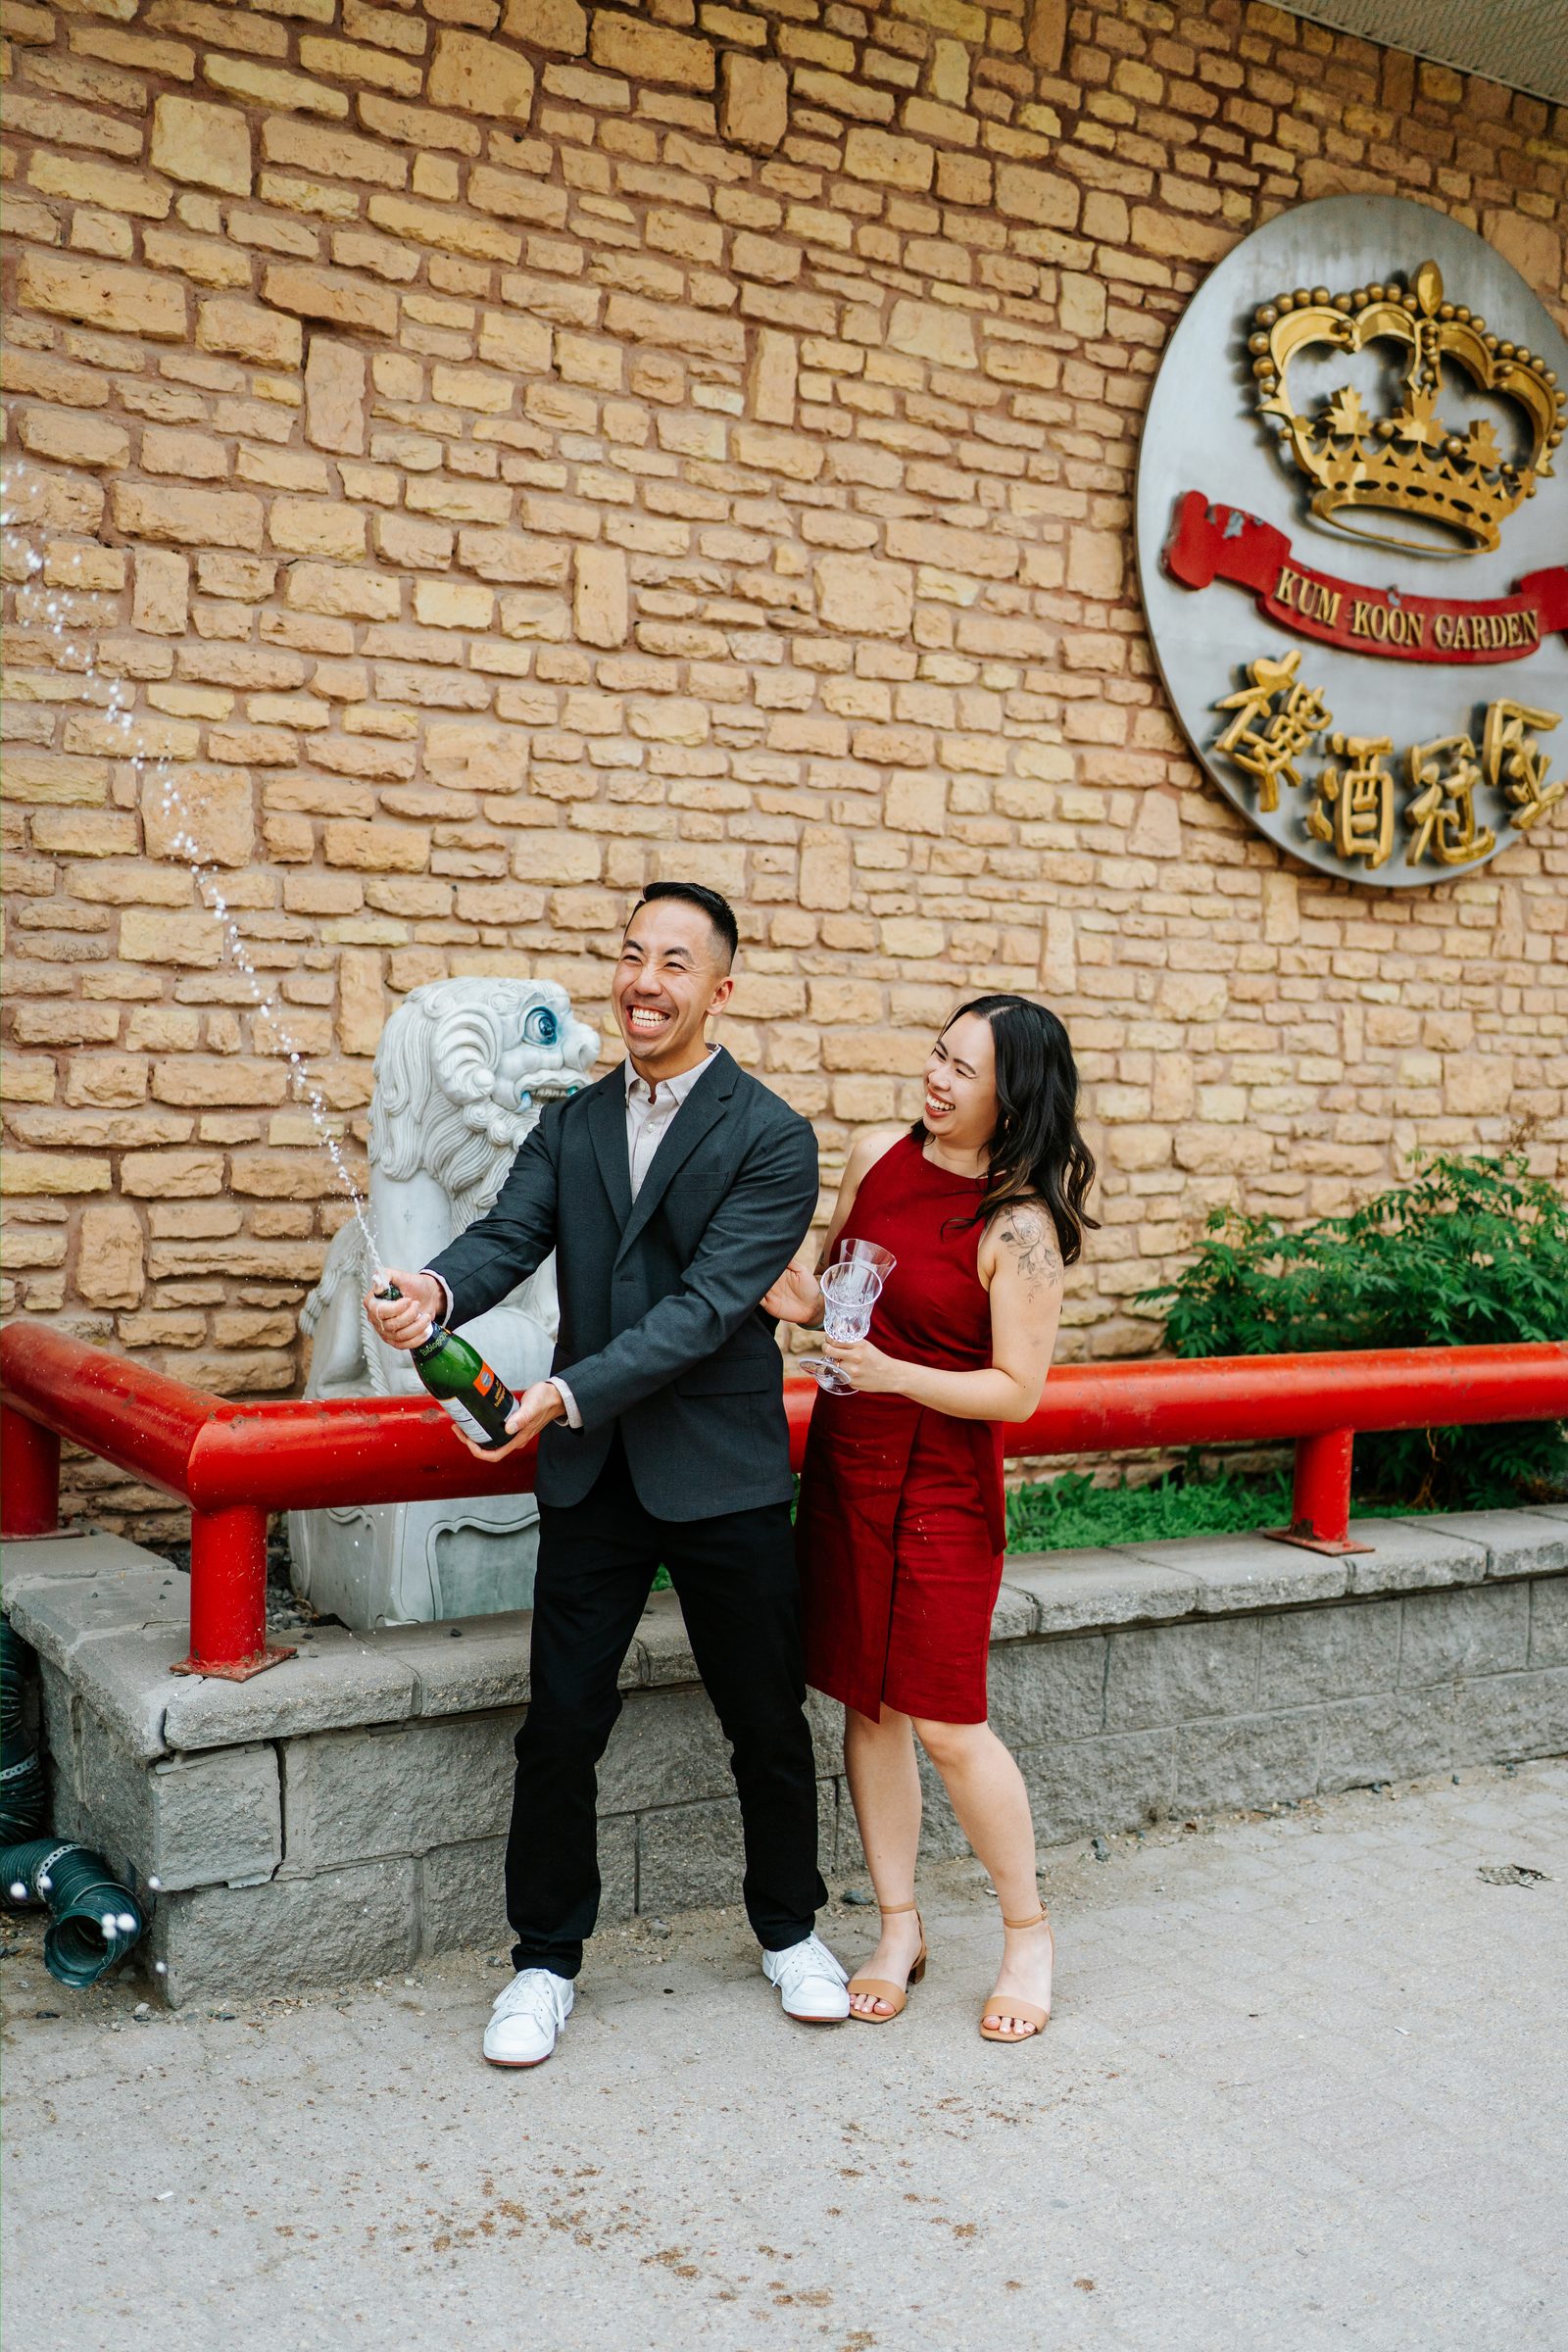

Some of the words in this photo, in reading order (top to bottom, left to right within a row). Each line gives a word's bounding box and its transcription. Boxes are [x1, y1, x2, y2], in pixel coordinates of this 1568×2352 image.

[1276, 566, 1342, 627] KUM
[1351, 601, 1424, 647] KOON
[1435, 611, 1539, 650] GARDEN
